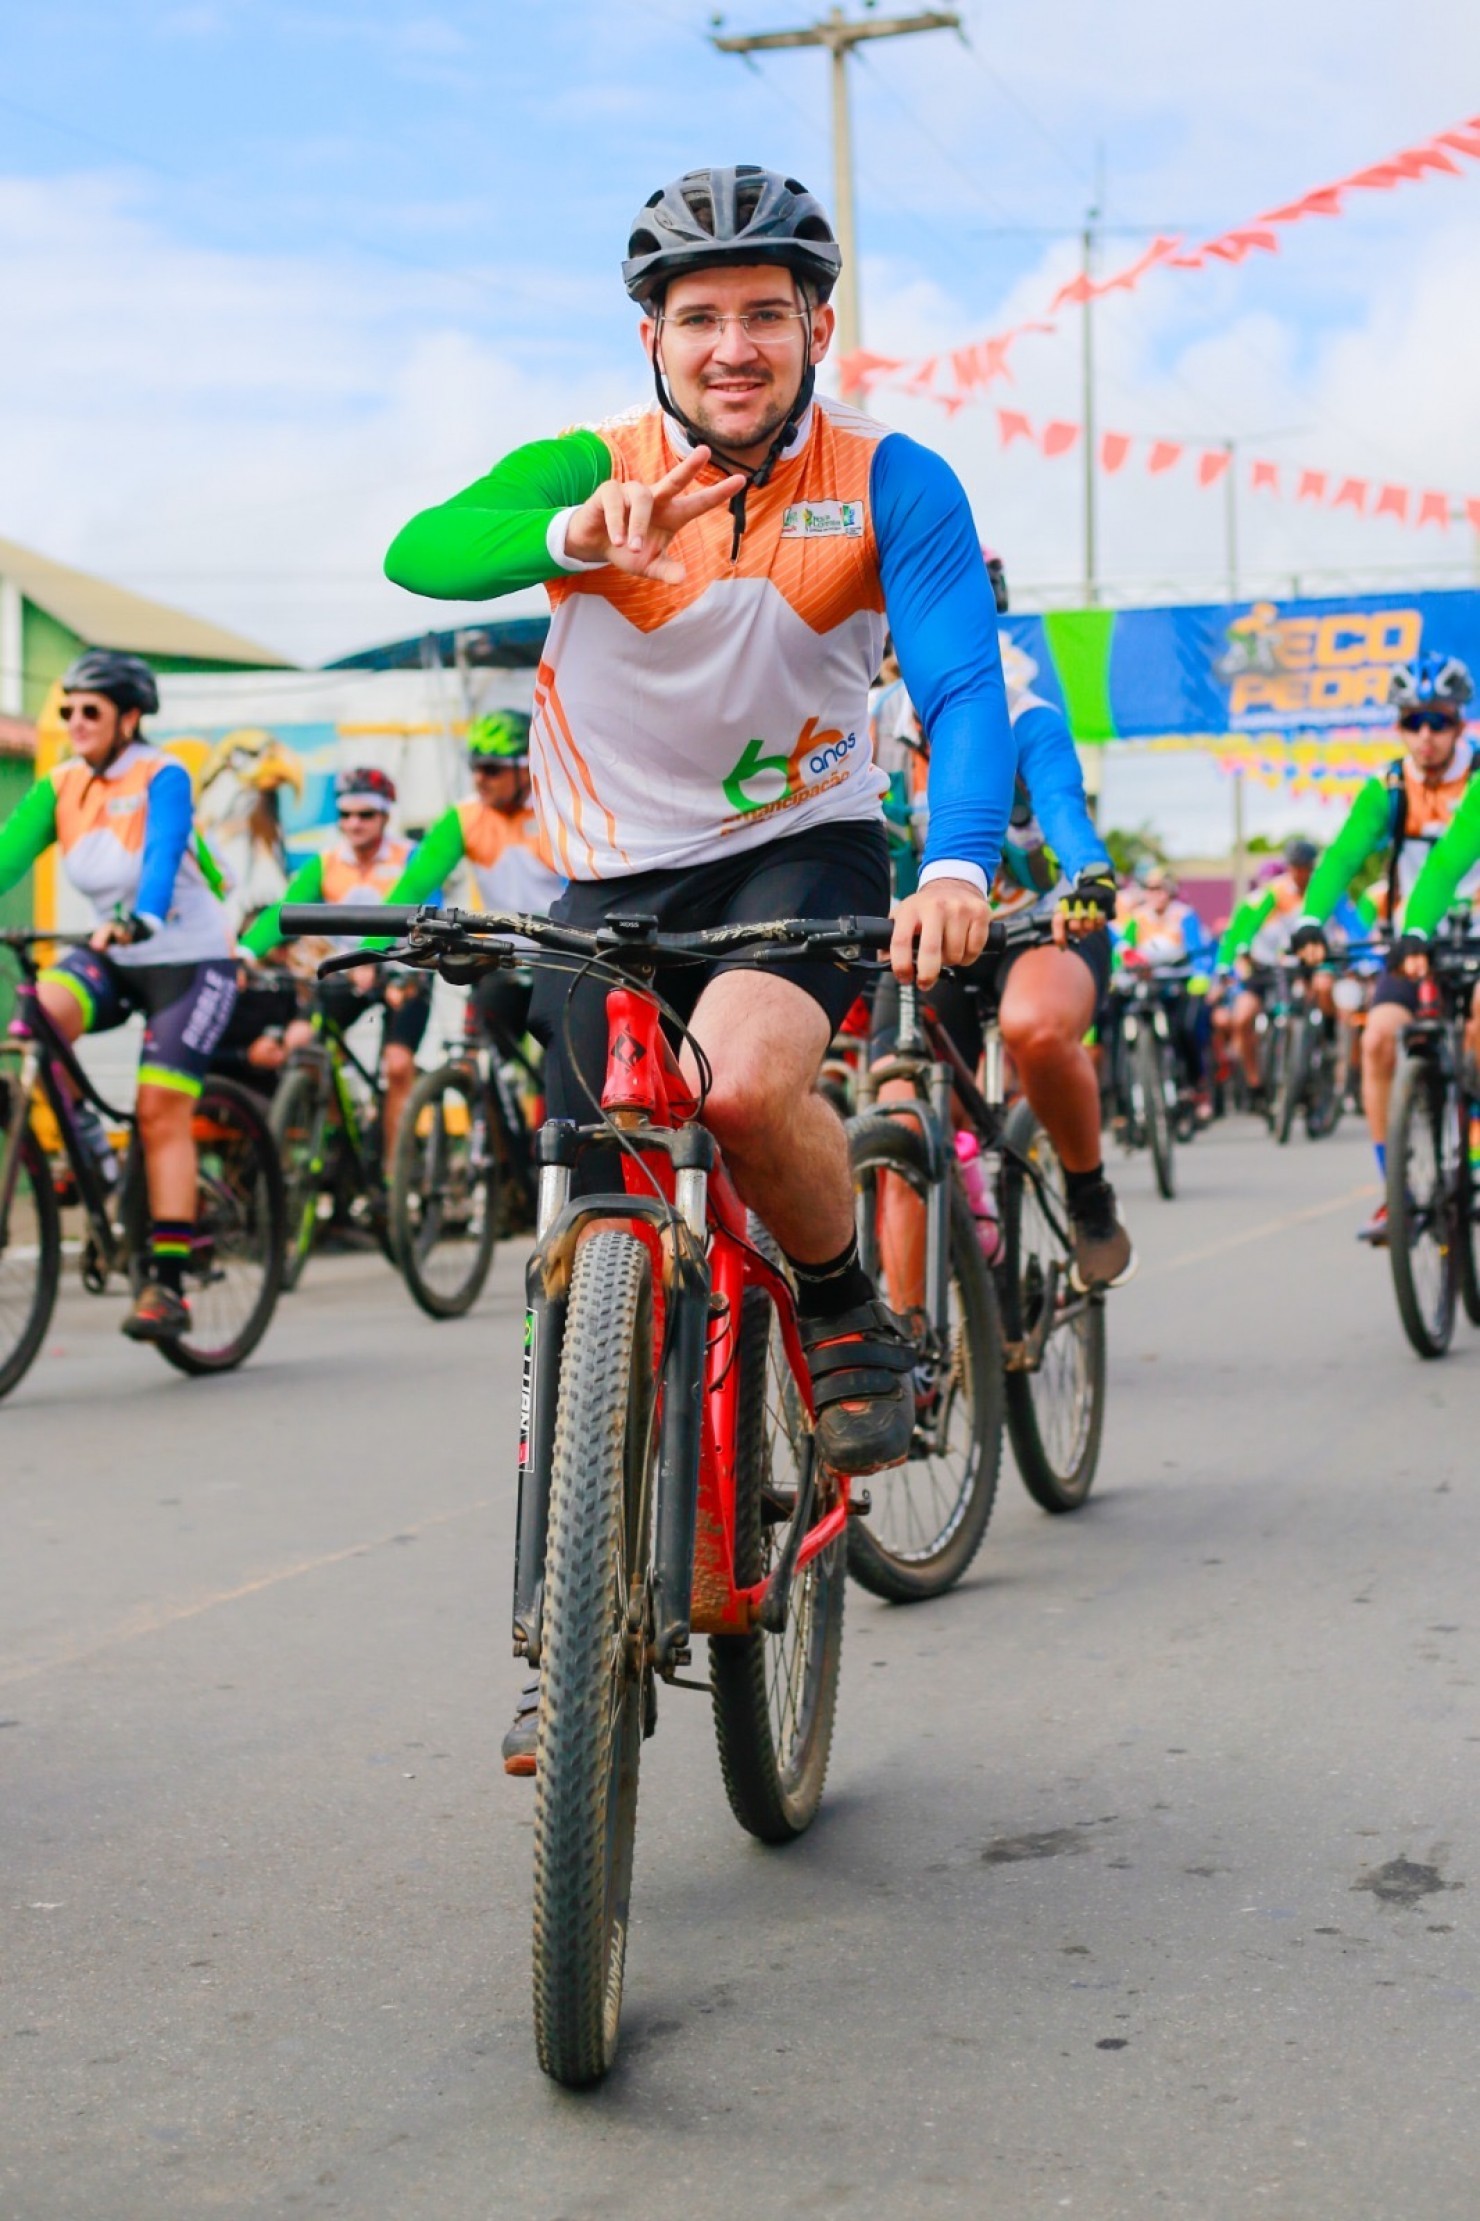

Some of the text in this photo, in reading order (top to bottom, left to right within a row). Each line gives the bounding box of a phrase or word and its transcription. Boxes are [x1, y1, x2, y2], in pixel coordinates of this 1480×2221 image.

[1275, 610, 1422, 668] ECO
[1231, 666, 1393, 714] PEDA
[810, 732, 855, 773] anos
